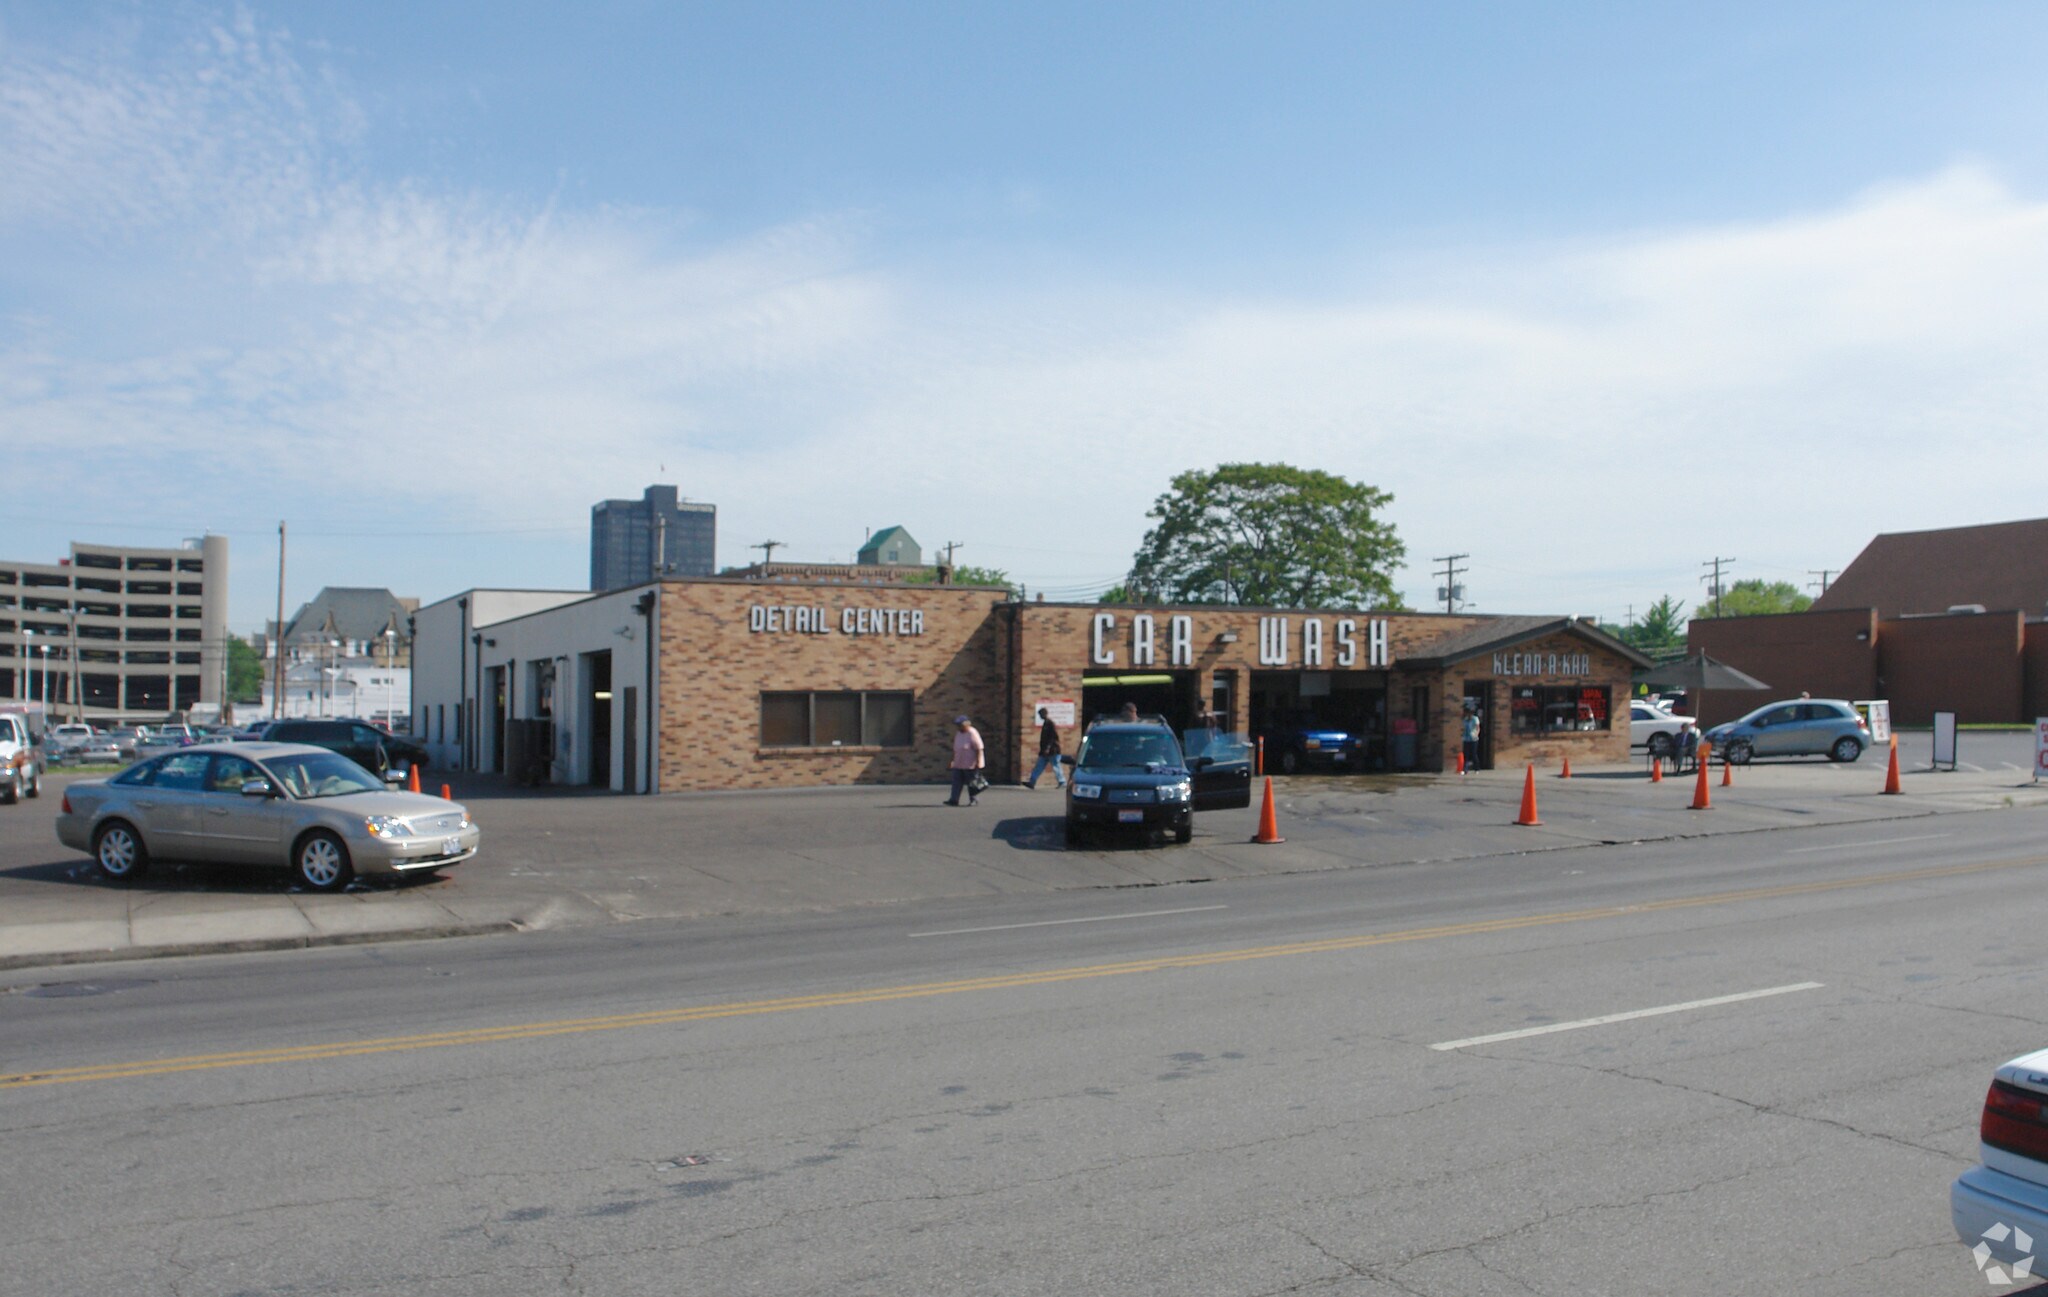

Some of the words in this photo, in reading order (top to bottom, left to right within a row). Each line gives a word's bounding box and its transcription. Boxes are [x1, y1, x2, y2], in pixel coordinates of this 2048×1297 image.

[750, 605, 830, 633] DETAIL
[842, 607, 924, 635] CENTER
[1093, 613, 1192, 666] CAR
[1259, 616, 1388, 667] WASH
